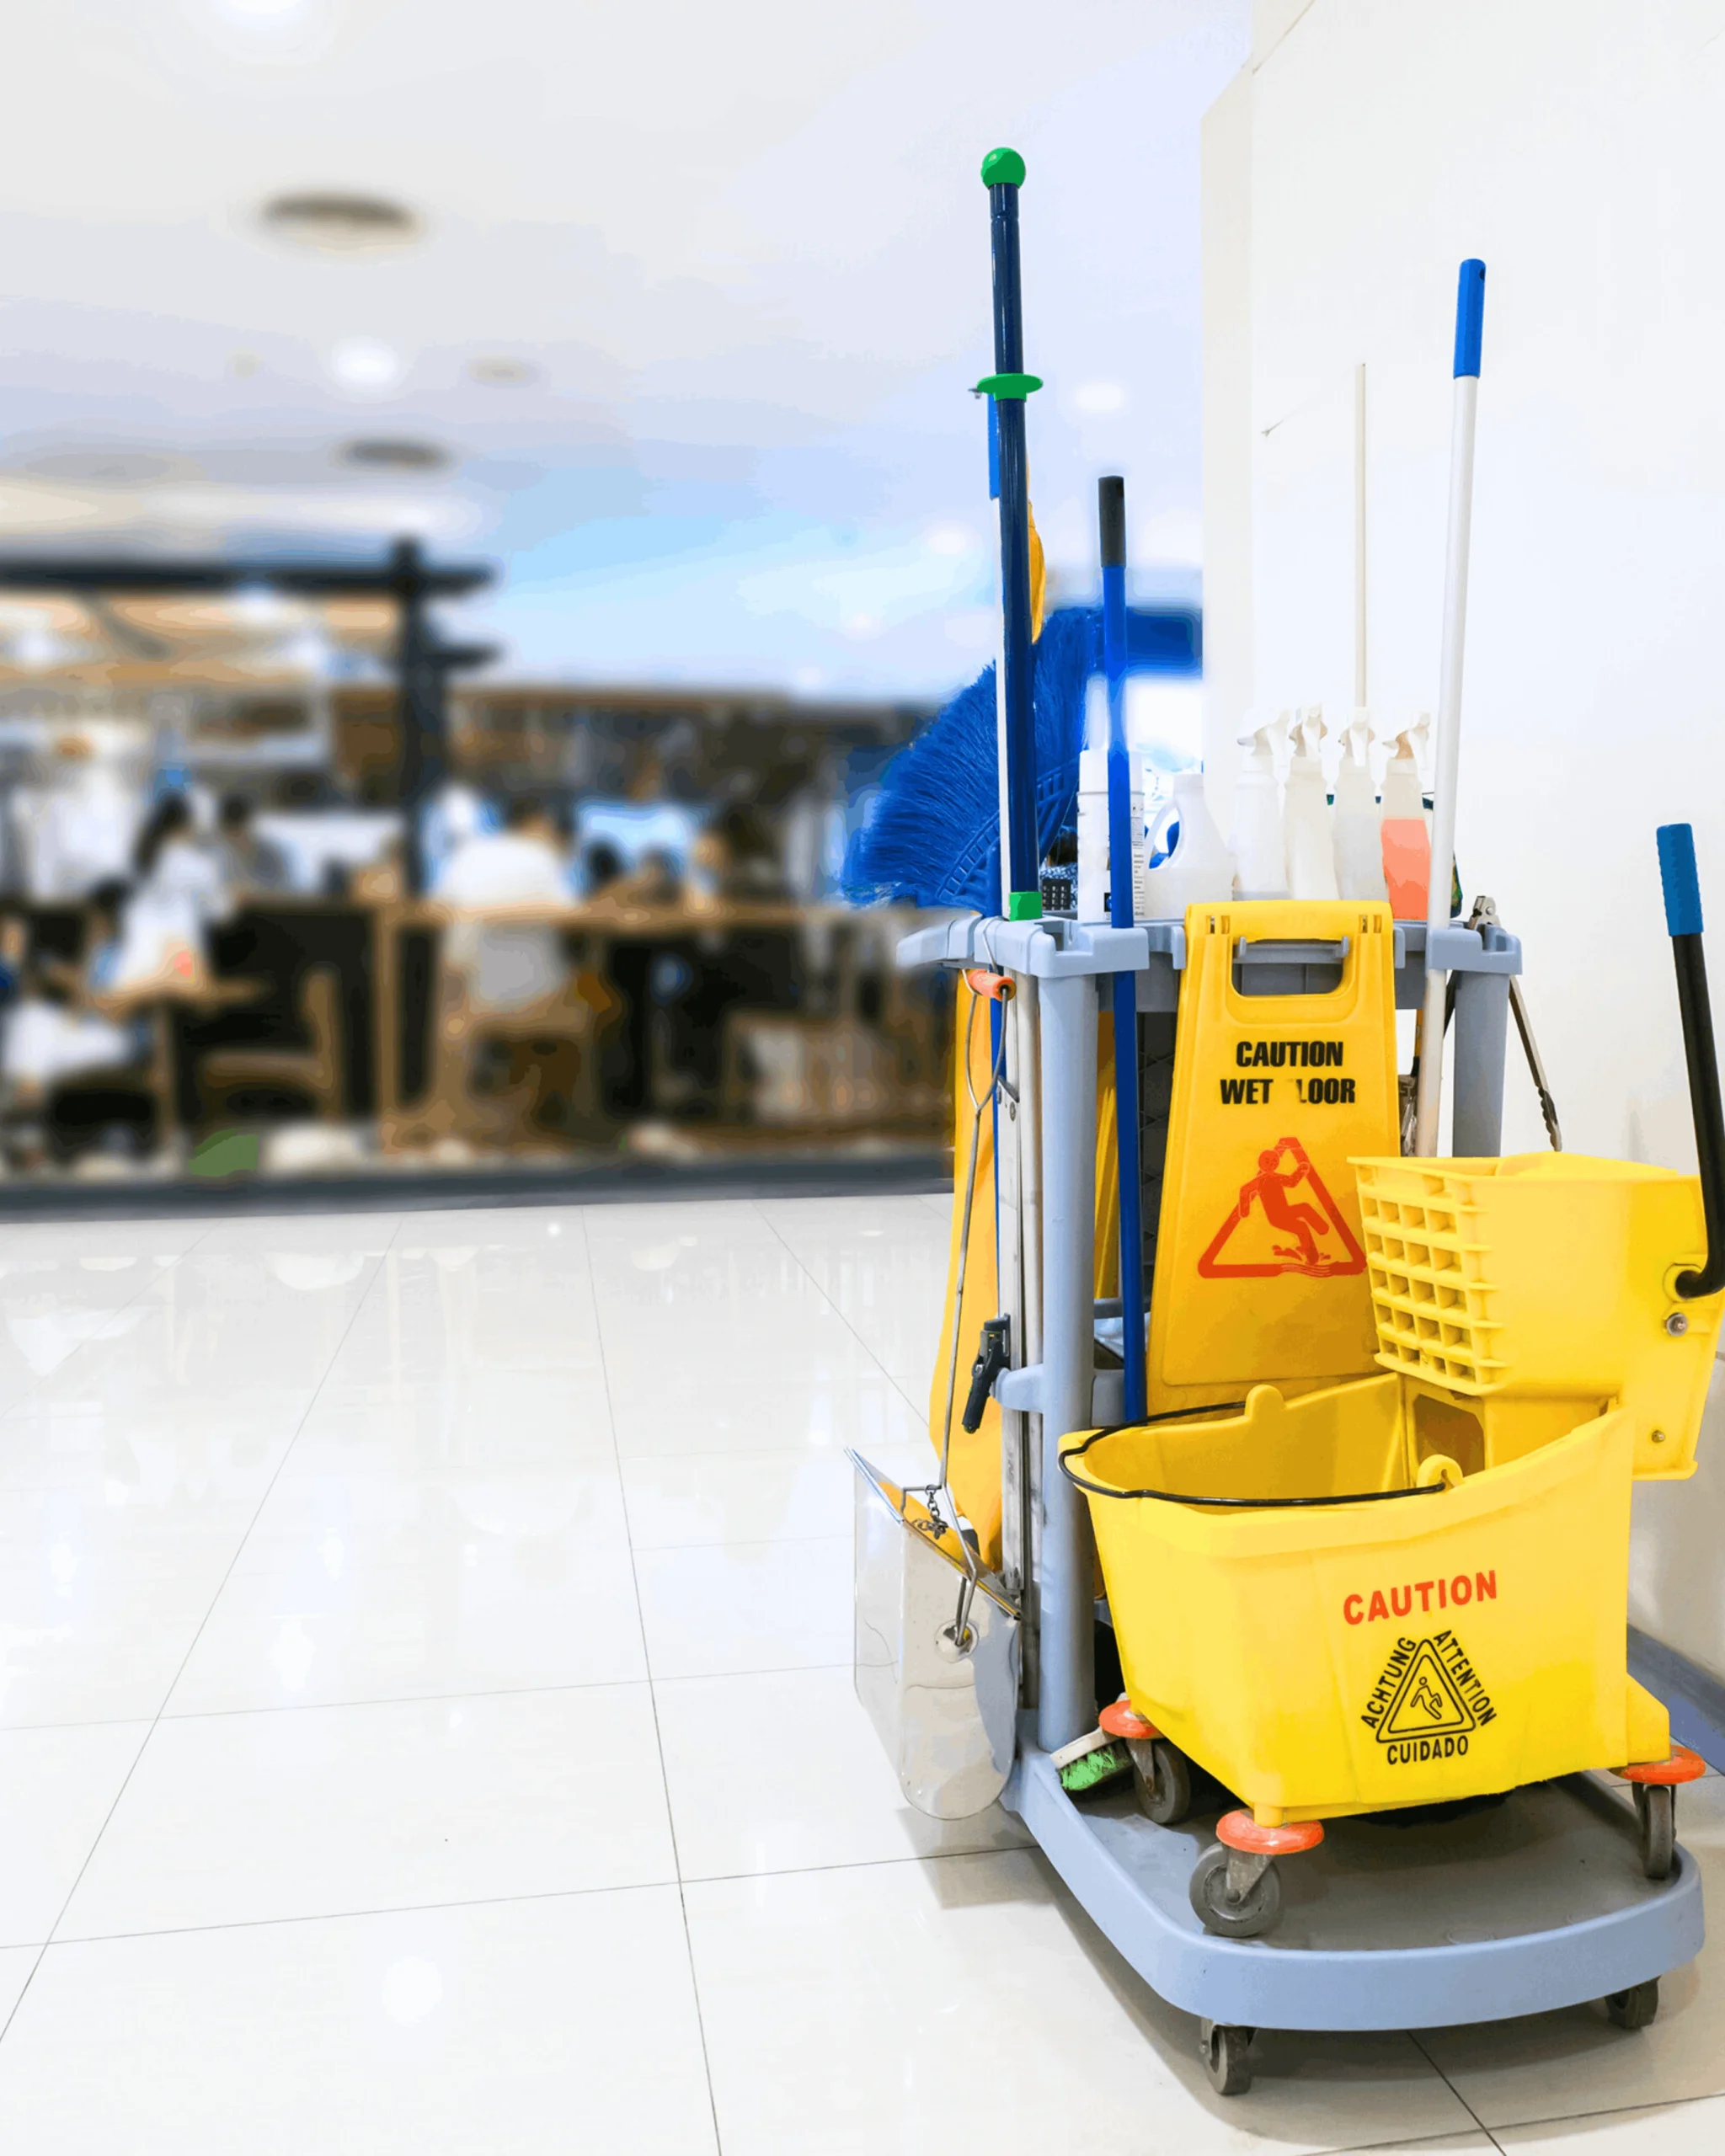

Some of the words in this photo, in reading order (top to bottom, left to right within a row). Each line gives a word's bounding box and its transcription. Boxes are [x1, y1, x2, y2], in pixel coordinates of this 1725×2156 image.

[1236, 1040, 1343, 1068] CAUTION
[1220, 1078, 1274, 1105] WET
[1343, 1570, 1497, 1625] CAUTION
[1360, 1637, 1417, 1729] ACHTUNG
[1433, 1630, 1498, 1726] ATTENTION
[1386, 1735, 1469, 1765] CUIDADO
